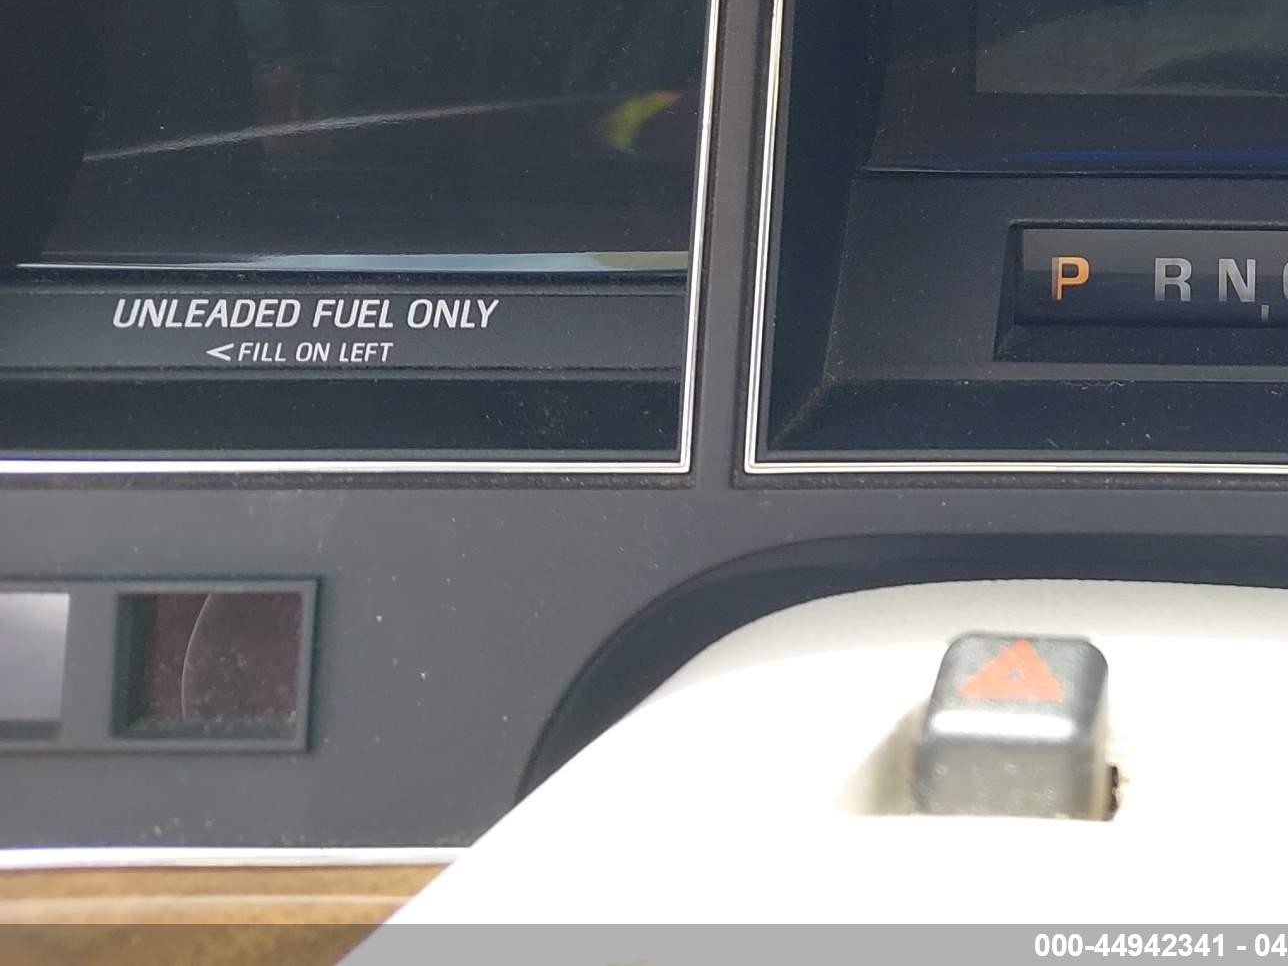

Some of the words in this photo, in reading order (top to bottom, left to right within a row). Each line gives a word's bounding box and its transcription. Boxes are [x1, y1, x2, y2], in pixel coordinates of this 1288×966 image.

[1051, 256, 1090, 301] P
[1154, 257, 1192, 301] R
[1217, 258, 1256, 302] N
[112, 298, 301, 329] UNLEADED
[312, 299, 394, 329] FUEL
[407, 298, 500, 329] ONLY
[237, 342, 287, 363] FILL
[295, 341, 331, 363] ON
[338, 342, 394, 363] LEFT
